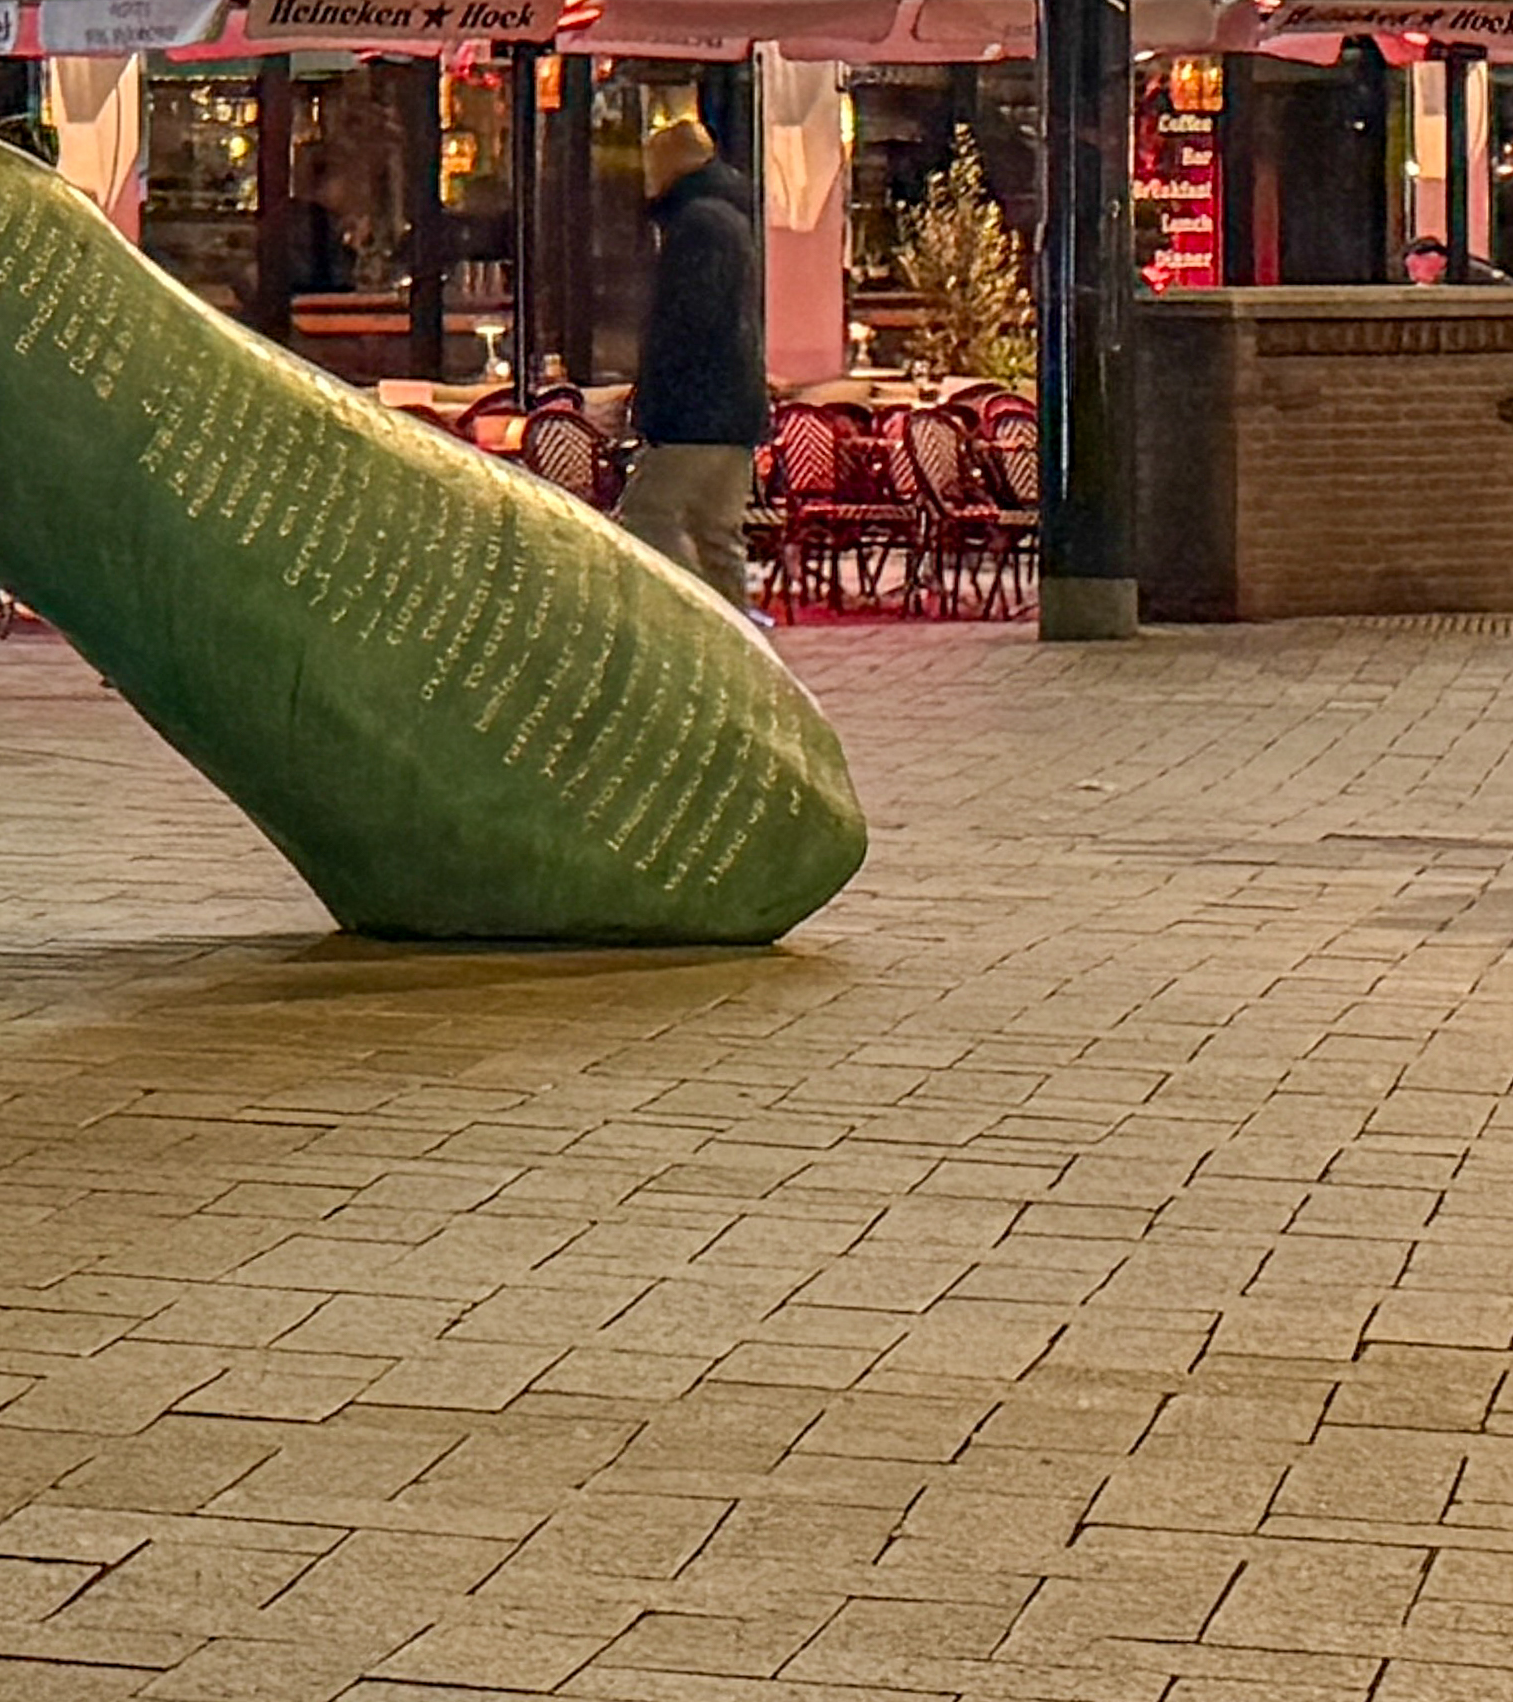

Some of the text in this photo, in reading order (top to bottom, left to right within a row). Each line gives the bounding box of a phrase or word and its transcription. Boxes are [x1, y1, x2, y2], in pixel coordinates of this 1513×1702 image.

[459, 1, 536, 30] Hoek
[1158, 113, 1214, 134] Coffee
[1181, 146, 1214, 167] Bar
[1162, 212, 1214, 233] Lunch
[1155, 249, 1214, 269] Dinner
